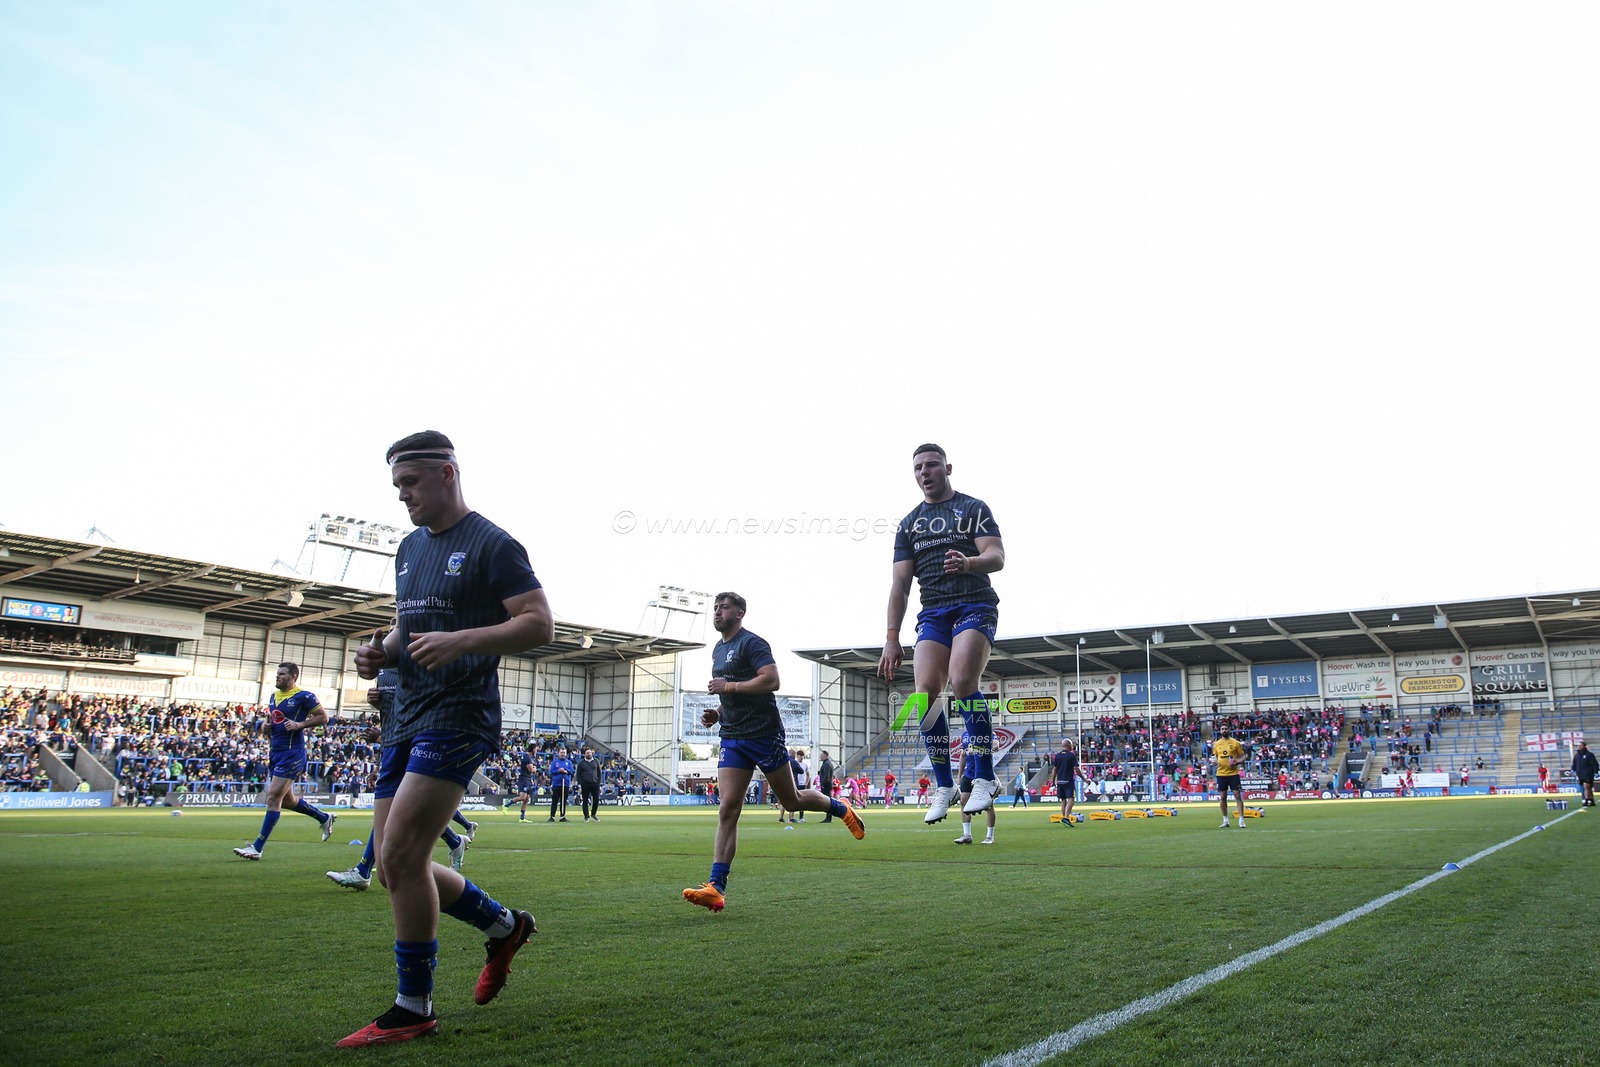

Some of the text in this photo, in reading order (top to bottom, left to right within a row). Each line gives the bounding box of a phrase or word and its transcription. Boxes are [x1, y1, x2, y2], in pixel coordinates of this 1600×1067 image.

[8, 602, 32, 610] NEXT
[431, 596, 454, 608] Park
[8, 608, 31, 616] HERE
[1507, 652, 1528, 660] Clean
[1356, 660, 1376, 668] Wash
[1482, 664, 1536, 676] GRILL
[2, 671, 168, 692] campus in Warrington
[1272, 674, 1312, 685] TYSERS
[182, 680, 254, 697] HALLIWELL
[1328, 682, 1371, 693] LiveWire
[1474, 680, 1546, 693] SQUARE
[1067, 688, 1116, 705] CDX
[16, 796, 102, 807] Halliwell Jones
[186, 794, 258, 804] PRIMAS LAW
